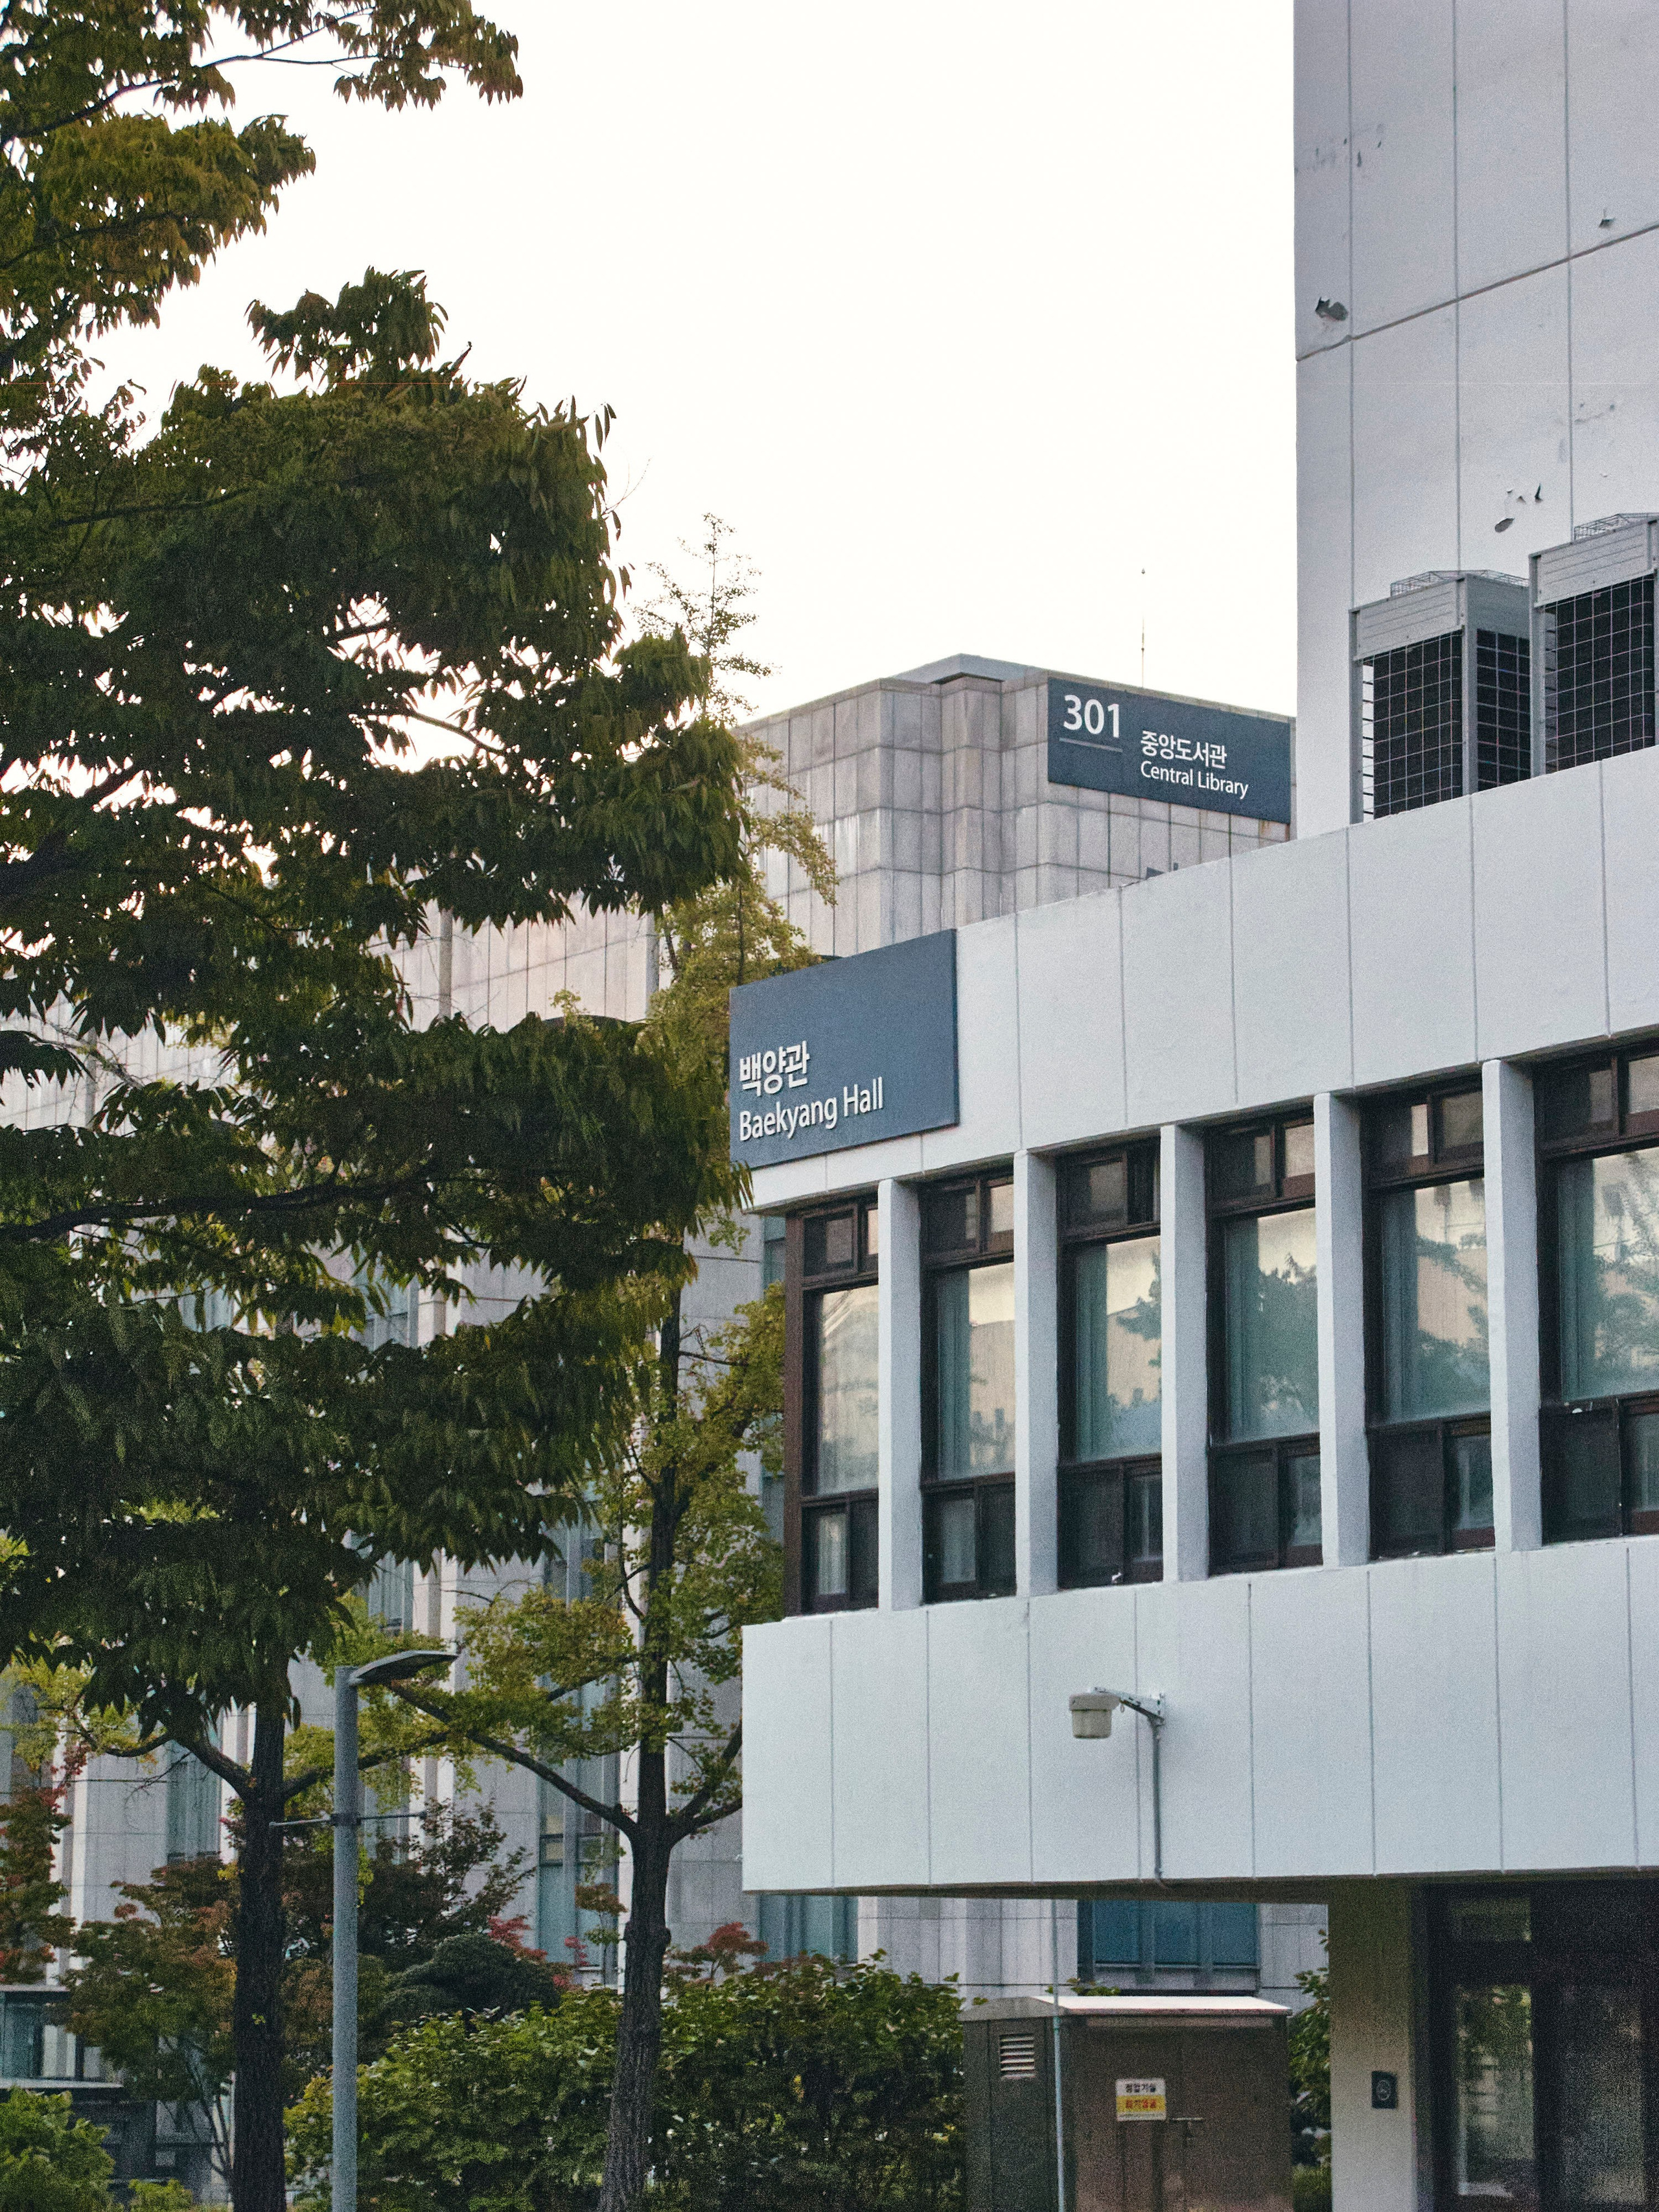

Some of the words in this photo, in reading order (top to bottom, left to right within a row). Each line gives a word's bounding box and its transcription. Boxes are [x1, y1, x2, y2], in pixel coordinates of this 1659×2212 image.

[1063, 694, 1120, 738] 301
[1141, 730, 1227, 769] 중앙도서관
[1141, 760, 1193, 786] Central
[1198, 771, 1249, 800] Library
[739, 1040, 810, 1097] 백양관
[739, 1097, 837, 1141] Baekyang
[843, 1076, 883, 1117] Hall
